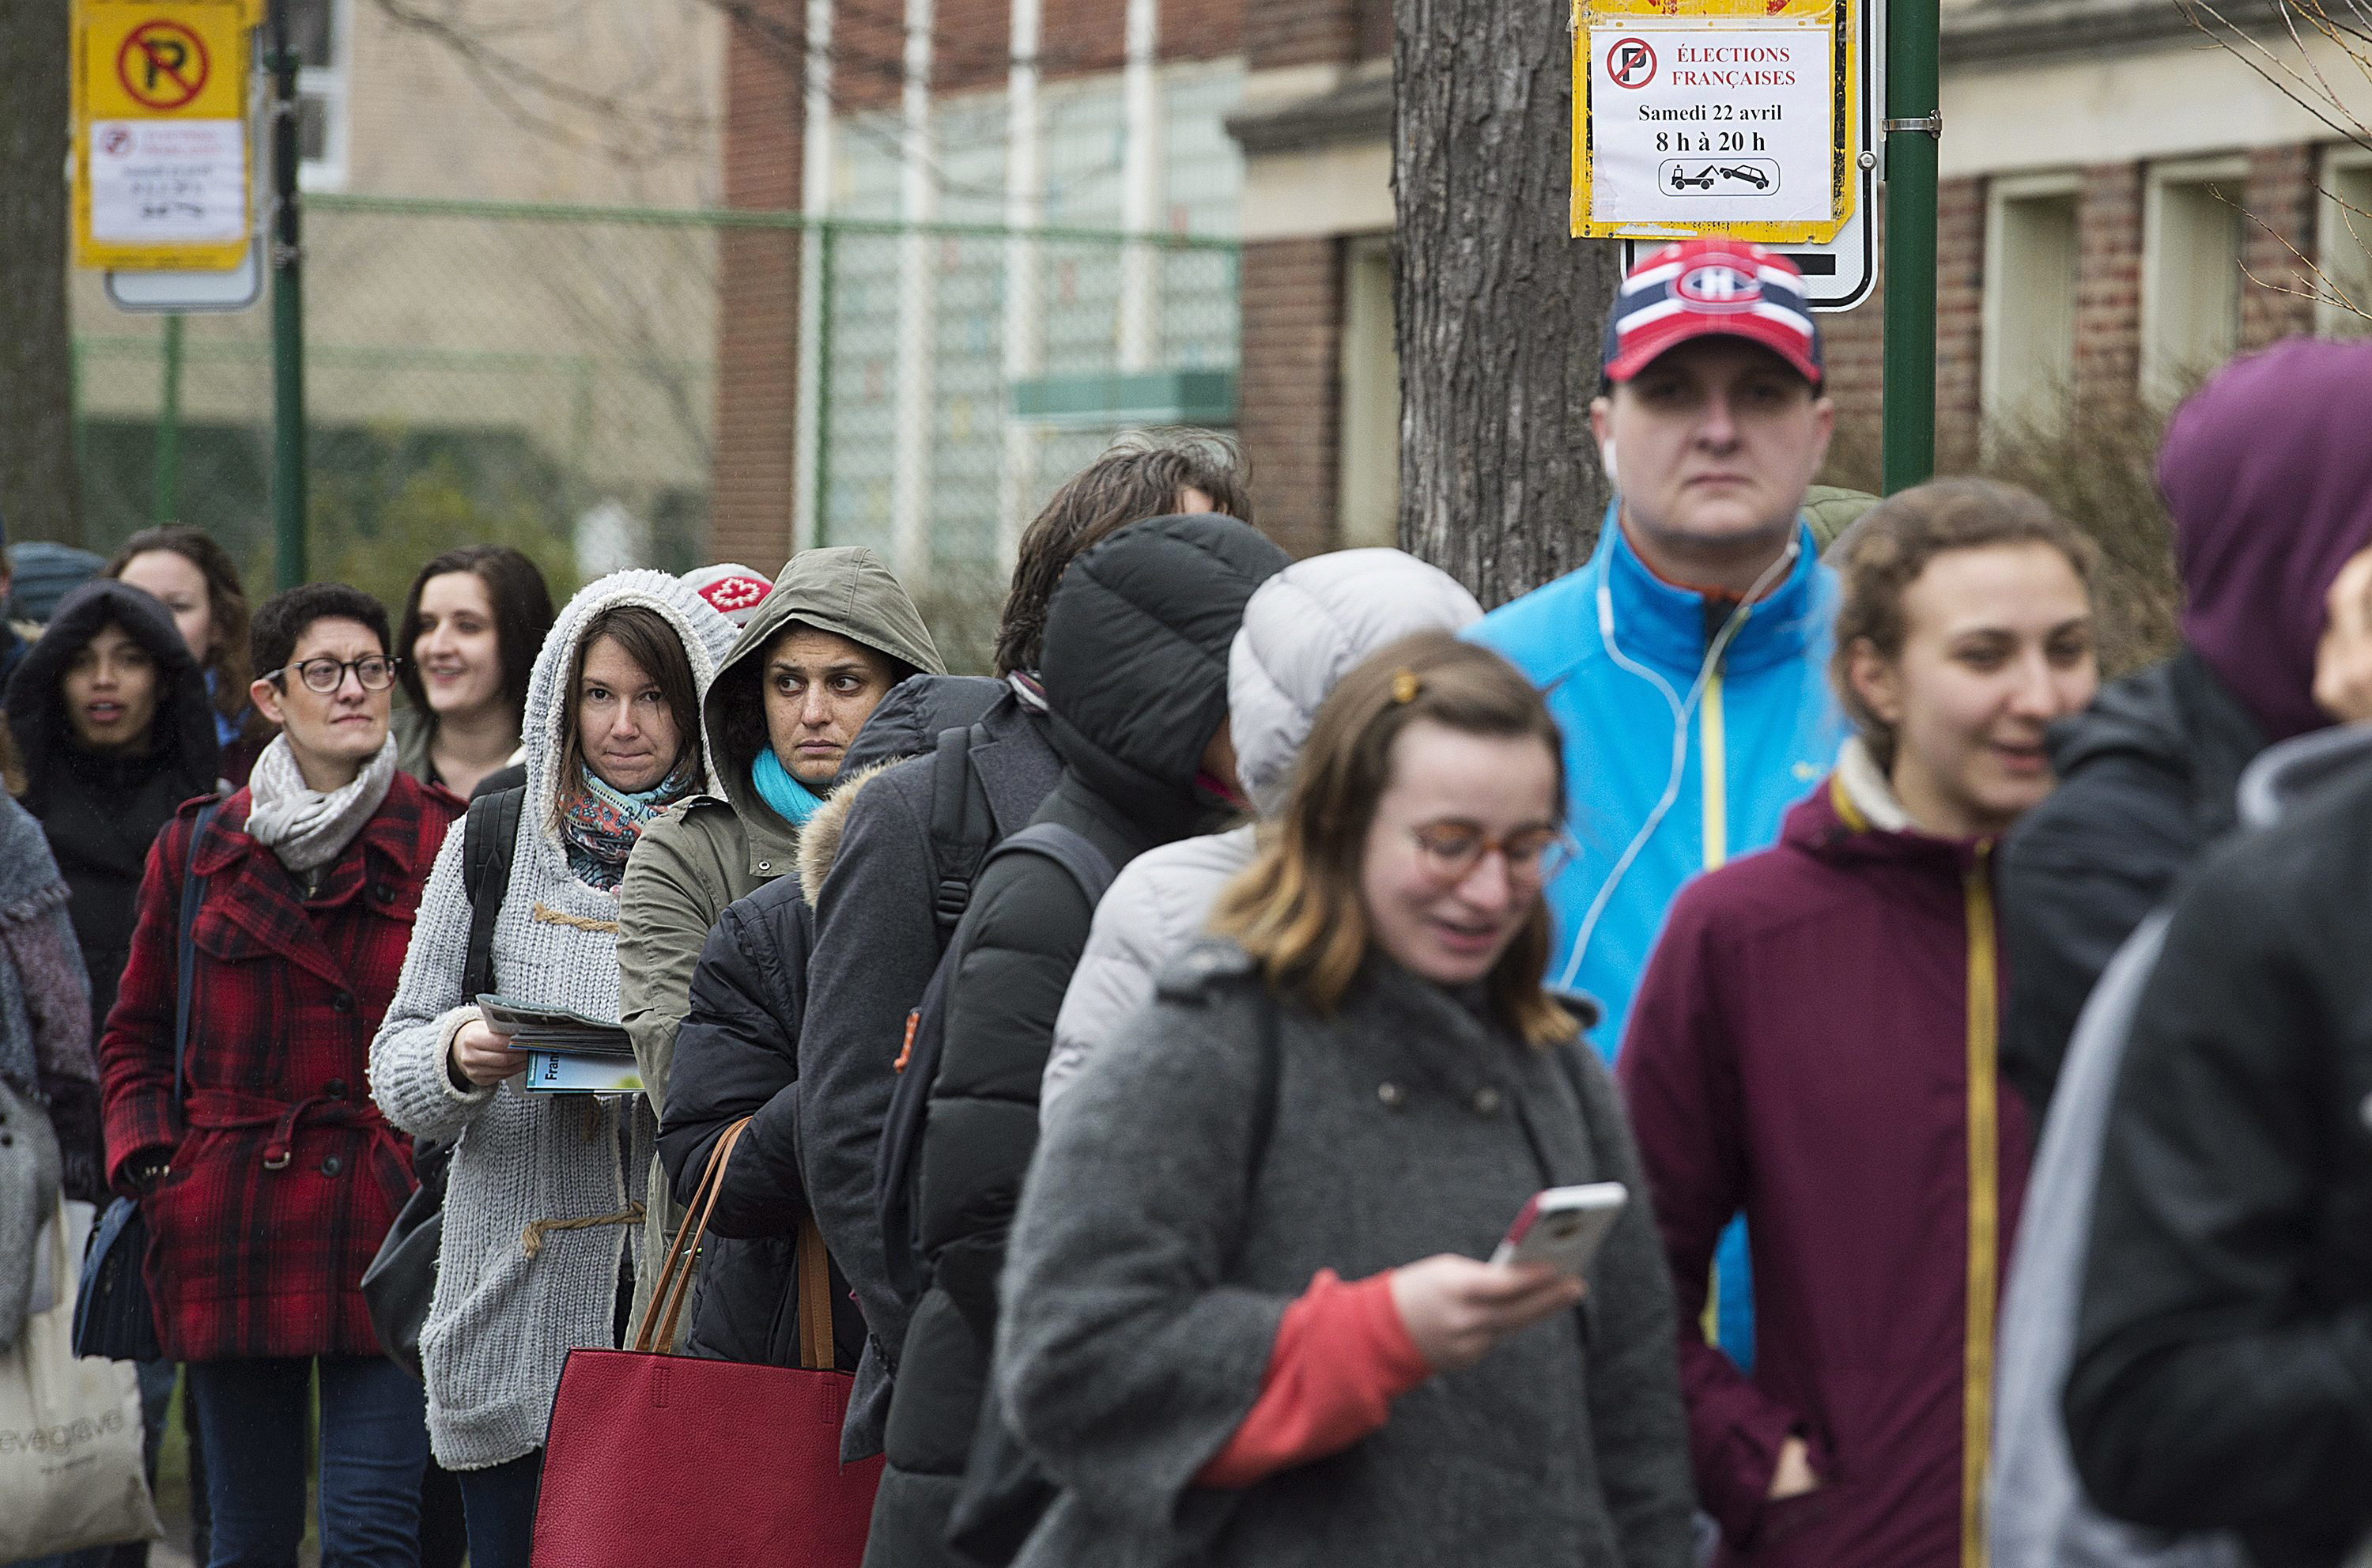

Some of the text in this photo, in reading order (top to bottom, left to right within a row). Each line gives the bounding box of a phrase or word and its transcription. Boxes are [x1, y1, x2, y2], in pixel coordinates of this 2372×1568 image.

[1677, 43, 1790, 62] ÉLECTIONS
[1672, 70, 1796, 89] FRANÇAISES
[1638, 104, 1782, 121] Samedi 22 avril
[1656, 131, 1766, 152] 8 h à 20 h
